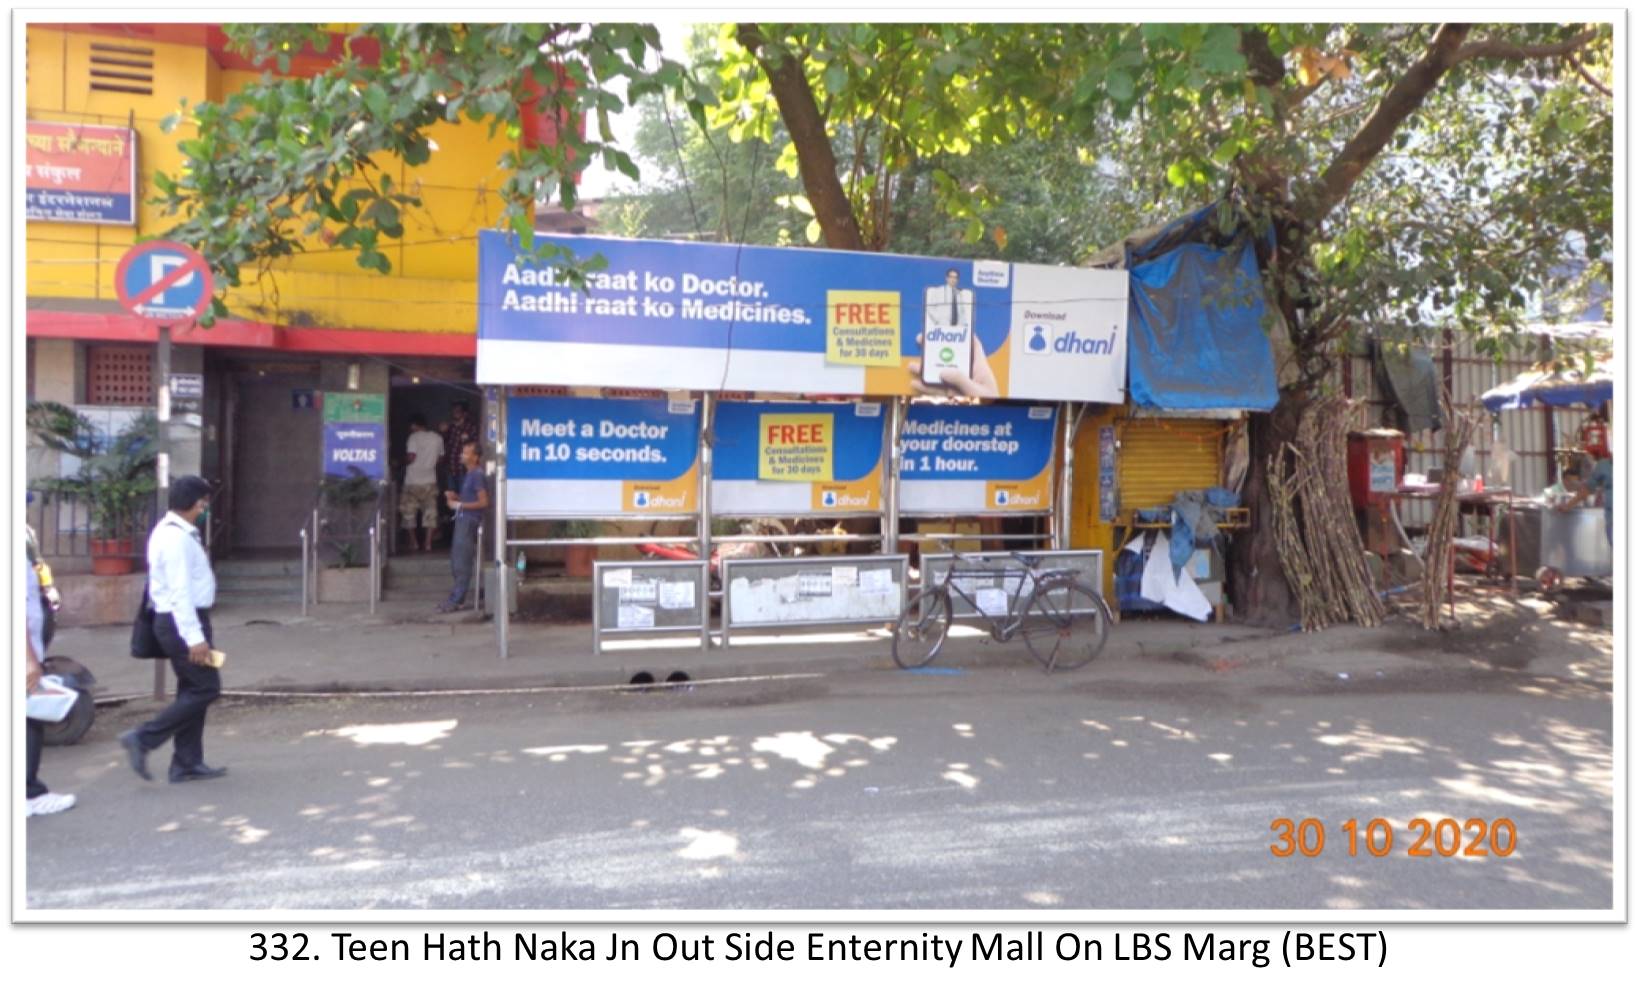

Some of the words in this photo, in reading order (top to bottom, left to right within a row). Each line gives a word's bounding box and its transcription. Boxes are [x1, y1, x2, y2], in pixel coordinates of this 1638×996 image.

[150, 254, 194, 305] P
[502, 263, 571, 288] Aad
[585, 271, 638, 291] raat
[644, 271, 675, 293] ko
[681, 273, 769, 298] Doctor.
[502, 289, 578, 314] Aadhi
[584, 296, 638, 316] raat
[644, 297, 675, 318] ko
[681, 298, 812, 325] Medicines.
[835, 303, 891, 325] FREE
[1024, 310, 1067, 321] Download
[832, 326, 895, 337] Consultations
[927, 323, 968, 342] dhani
[1054, 325, 1118, 355] dhani
[846, 338, 893, 347] Medicines
[869, 348, 890, 358] days
[520, 419, 576, 438] Meet
[580, 423, 594, 438] a
[599, 420, 668, 440] Doctor
[767, 424, 824, 445] FREE
[902, 420, 990, 436] Medicines
[994, 422, 1013, 437] at
[332, 448, 377, 462] VOLTAS
[520, 444, 541, 461] in
[545, 444, 571, 462] 10
[575, 445, 667, 464] seconds.
[900, 438, 939, 454] your
[900, 456, 915, 471] in
[920, 457, 931, 471] 1
[935, 456, 979, 471] hour.
